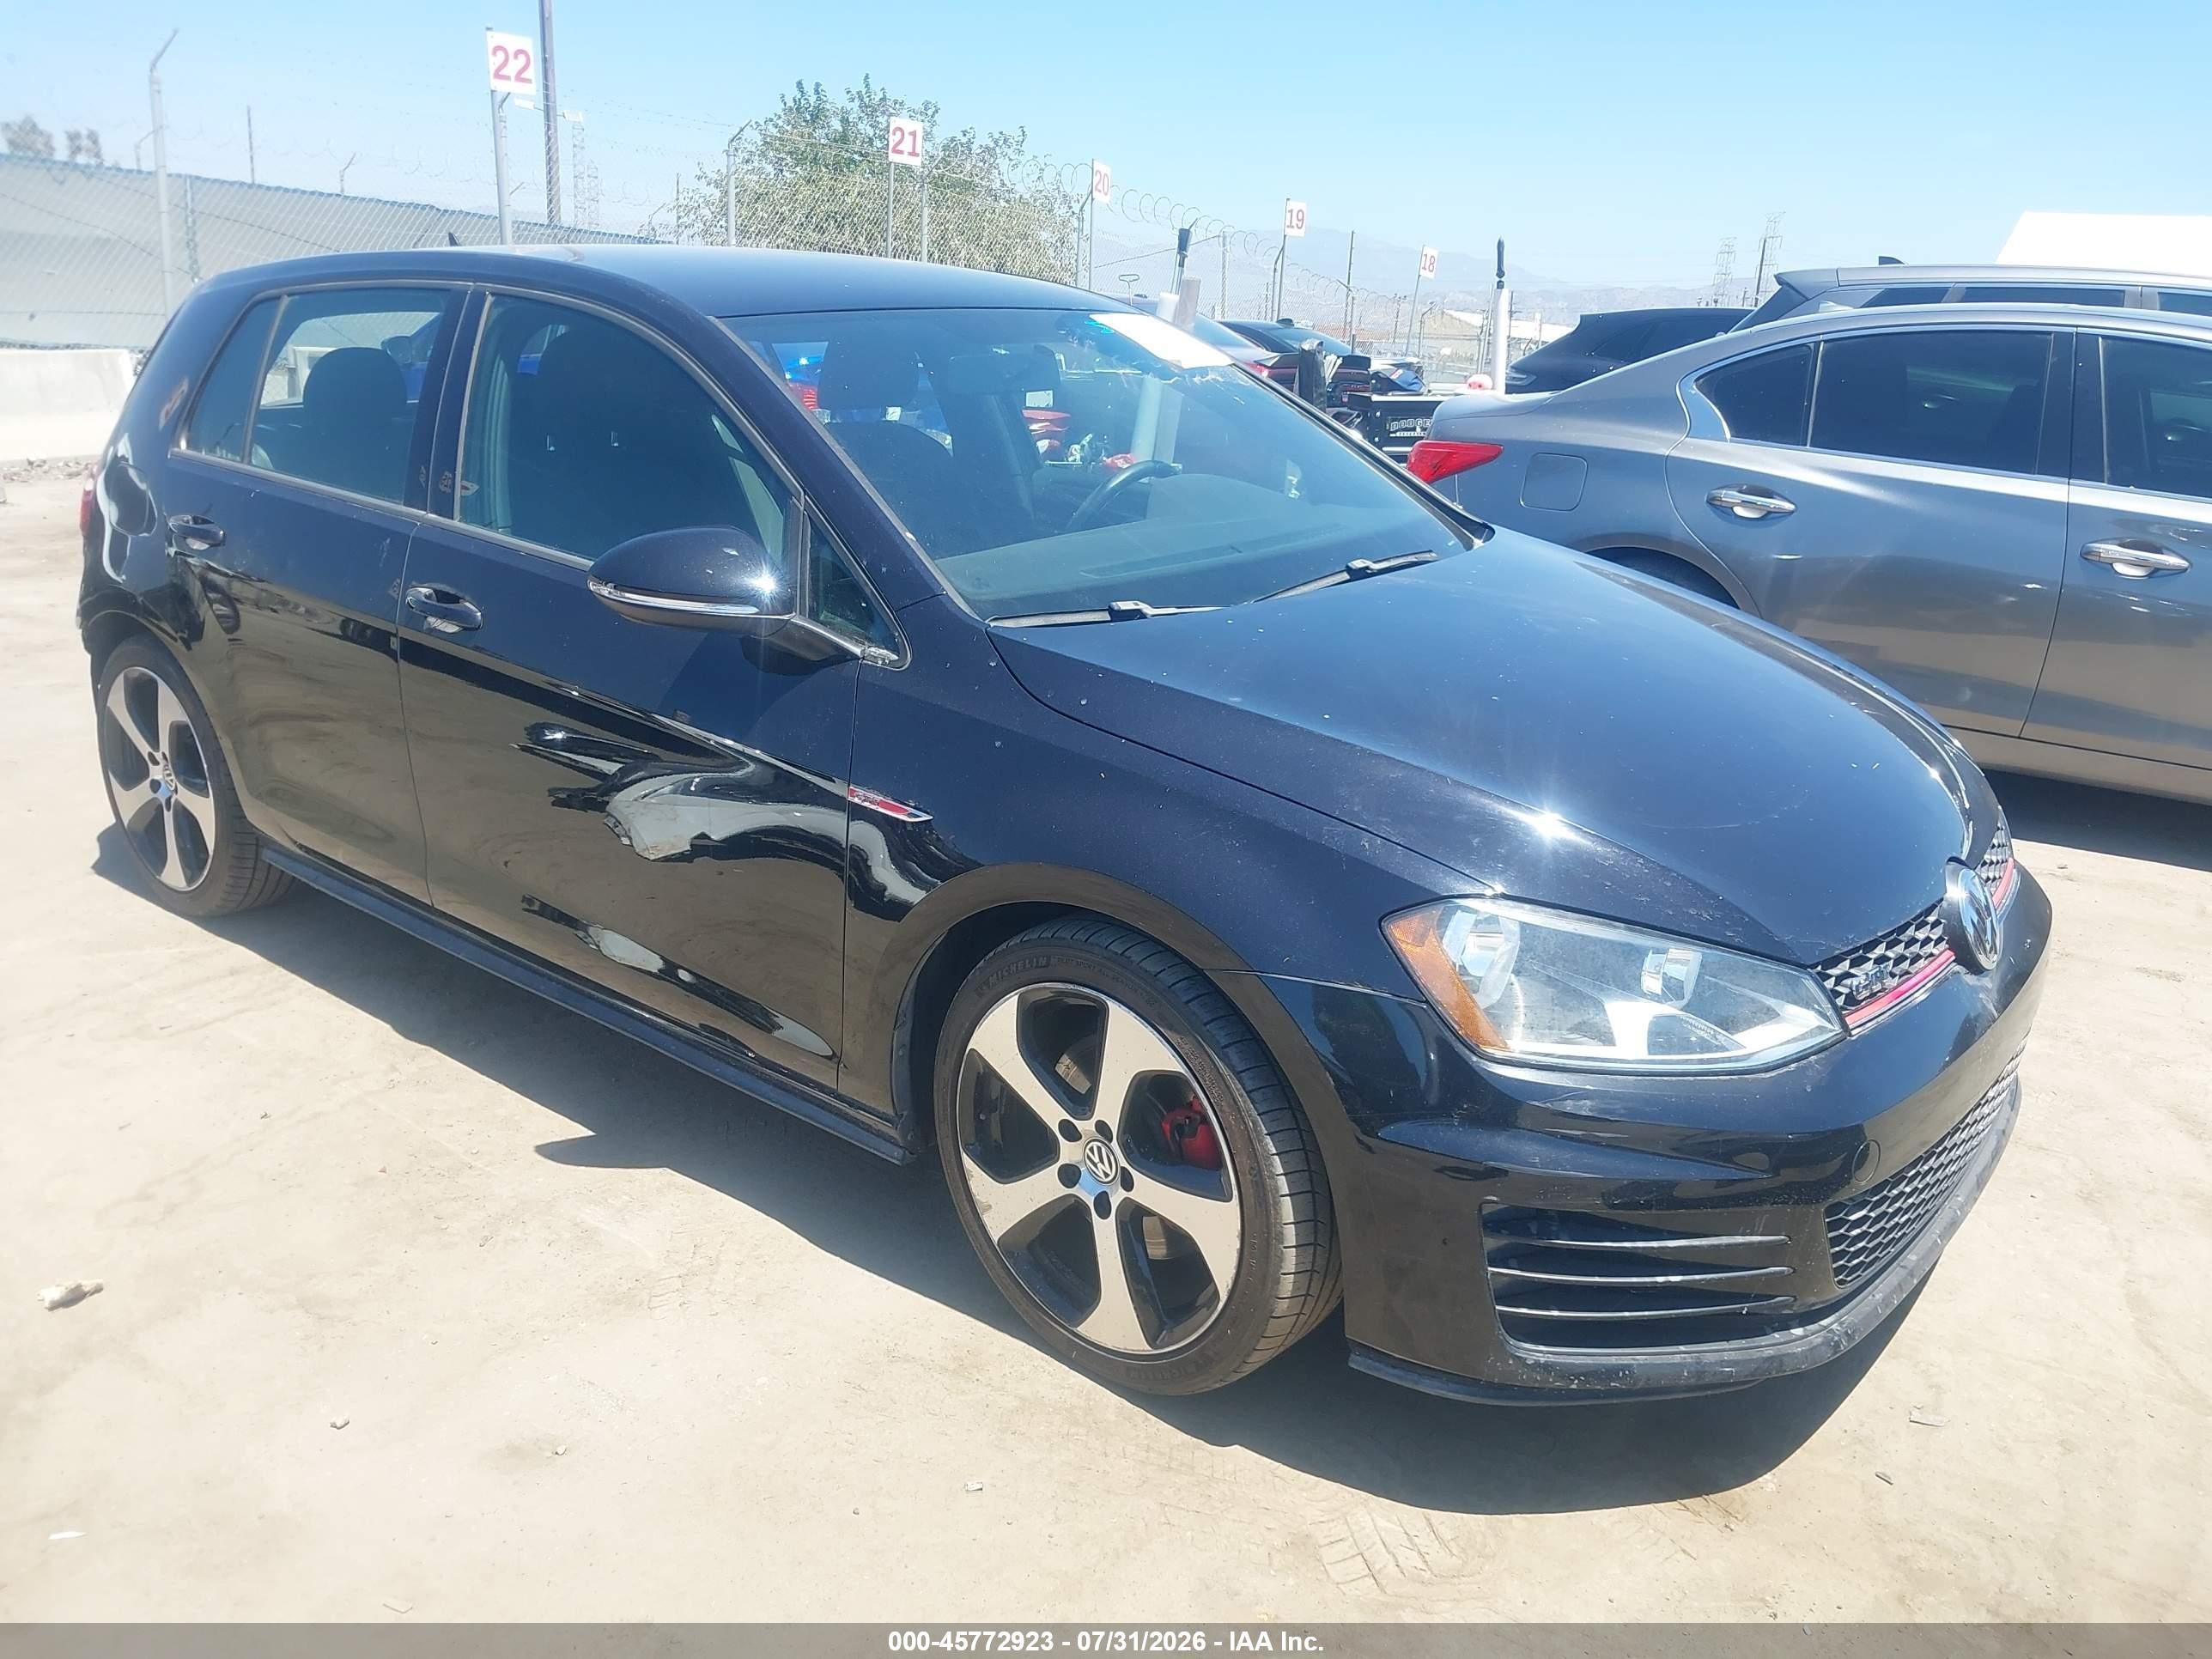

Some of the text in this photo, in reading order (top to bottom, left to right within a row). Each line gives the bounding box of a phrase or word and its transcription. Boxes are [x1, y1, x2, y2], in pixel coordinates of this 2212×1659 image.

[491, 45, 533, 84] 22
[891, 126, 920, 157] 21
[1095, 170, 1109, 196] 20
[1286, 208, 1305, 229] 19
[1422, 253, 1436, 273] 18
[988, 955, 1048, 988] MICHELIN
